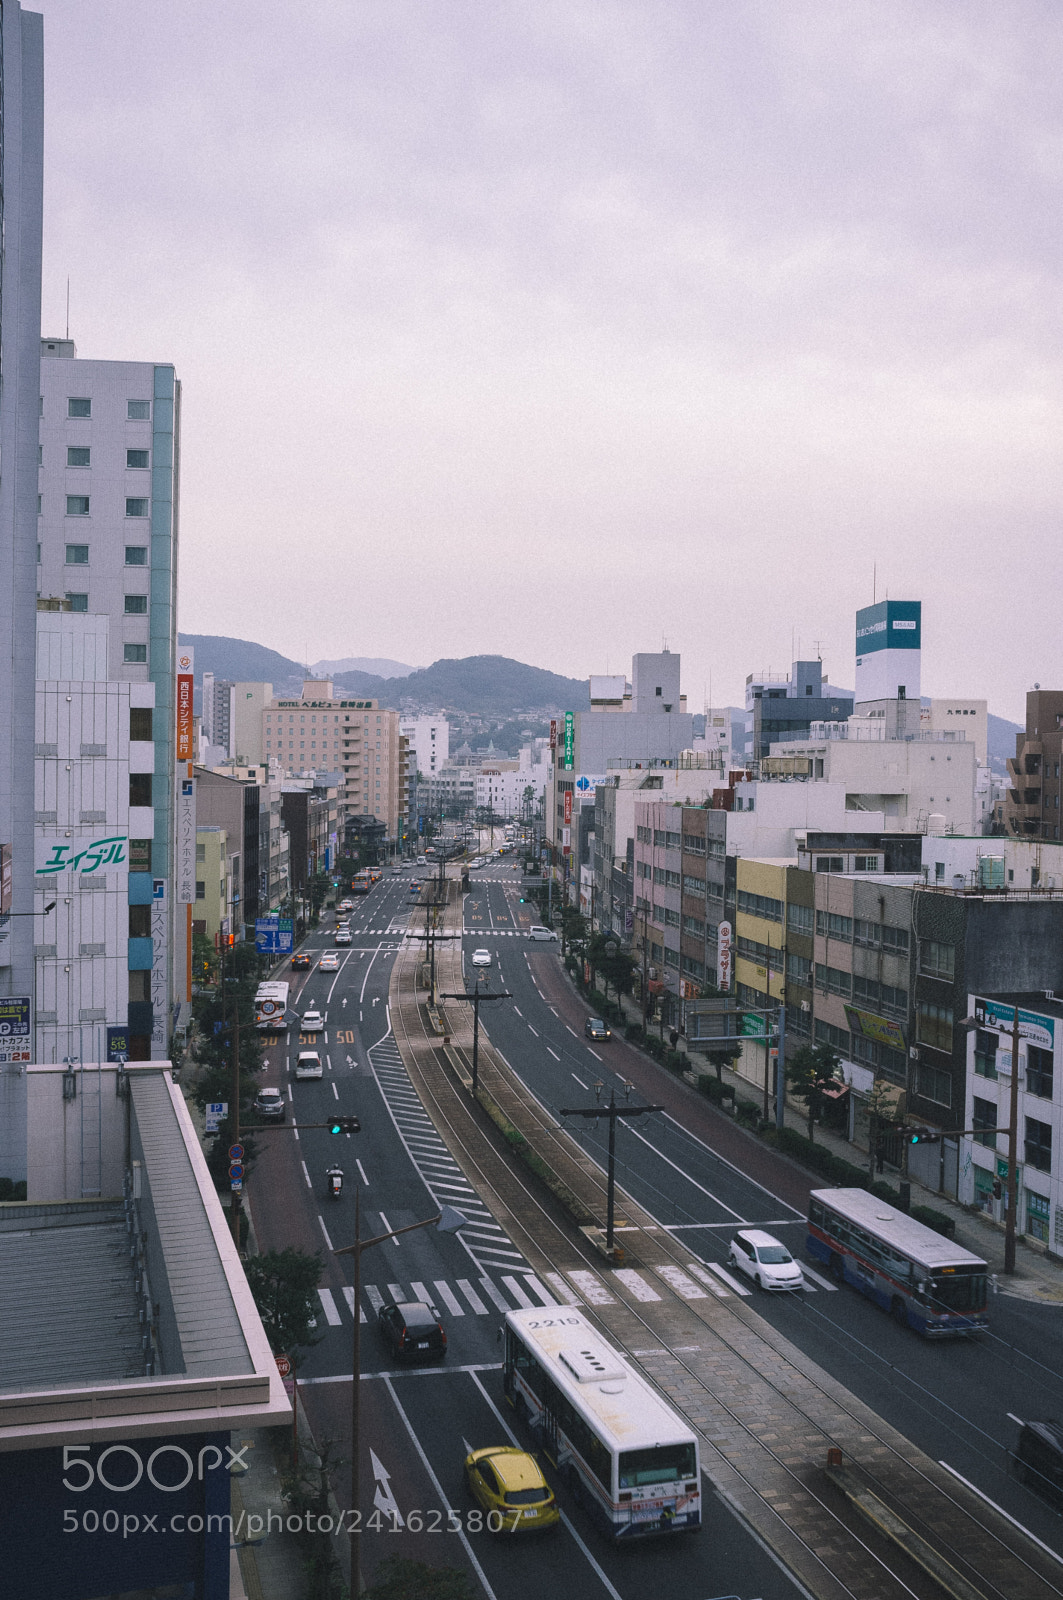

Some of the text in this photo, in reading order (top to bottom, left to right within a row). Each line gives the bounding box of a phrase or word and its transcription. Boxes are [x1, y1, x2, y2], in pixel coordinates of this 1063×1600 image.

[179, 682, 190, 753] 西日本シティ銀行
[36, 836, 127, 874] エイブル
[263, 1003, 274, 1012] 50
[0, 1037, 30, 1045] トカフェ
[336, 1030, 354, 1044] 50
[111, 1040, 127, 1050] 515
